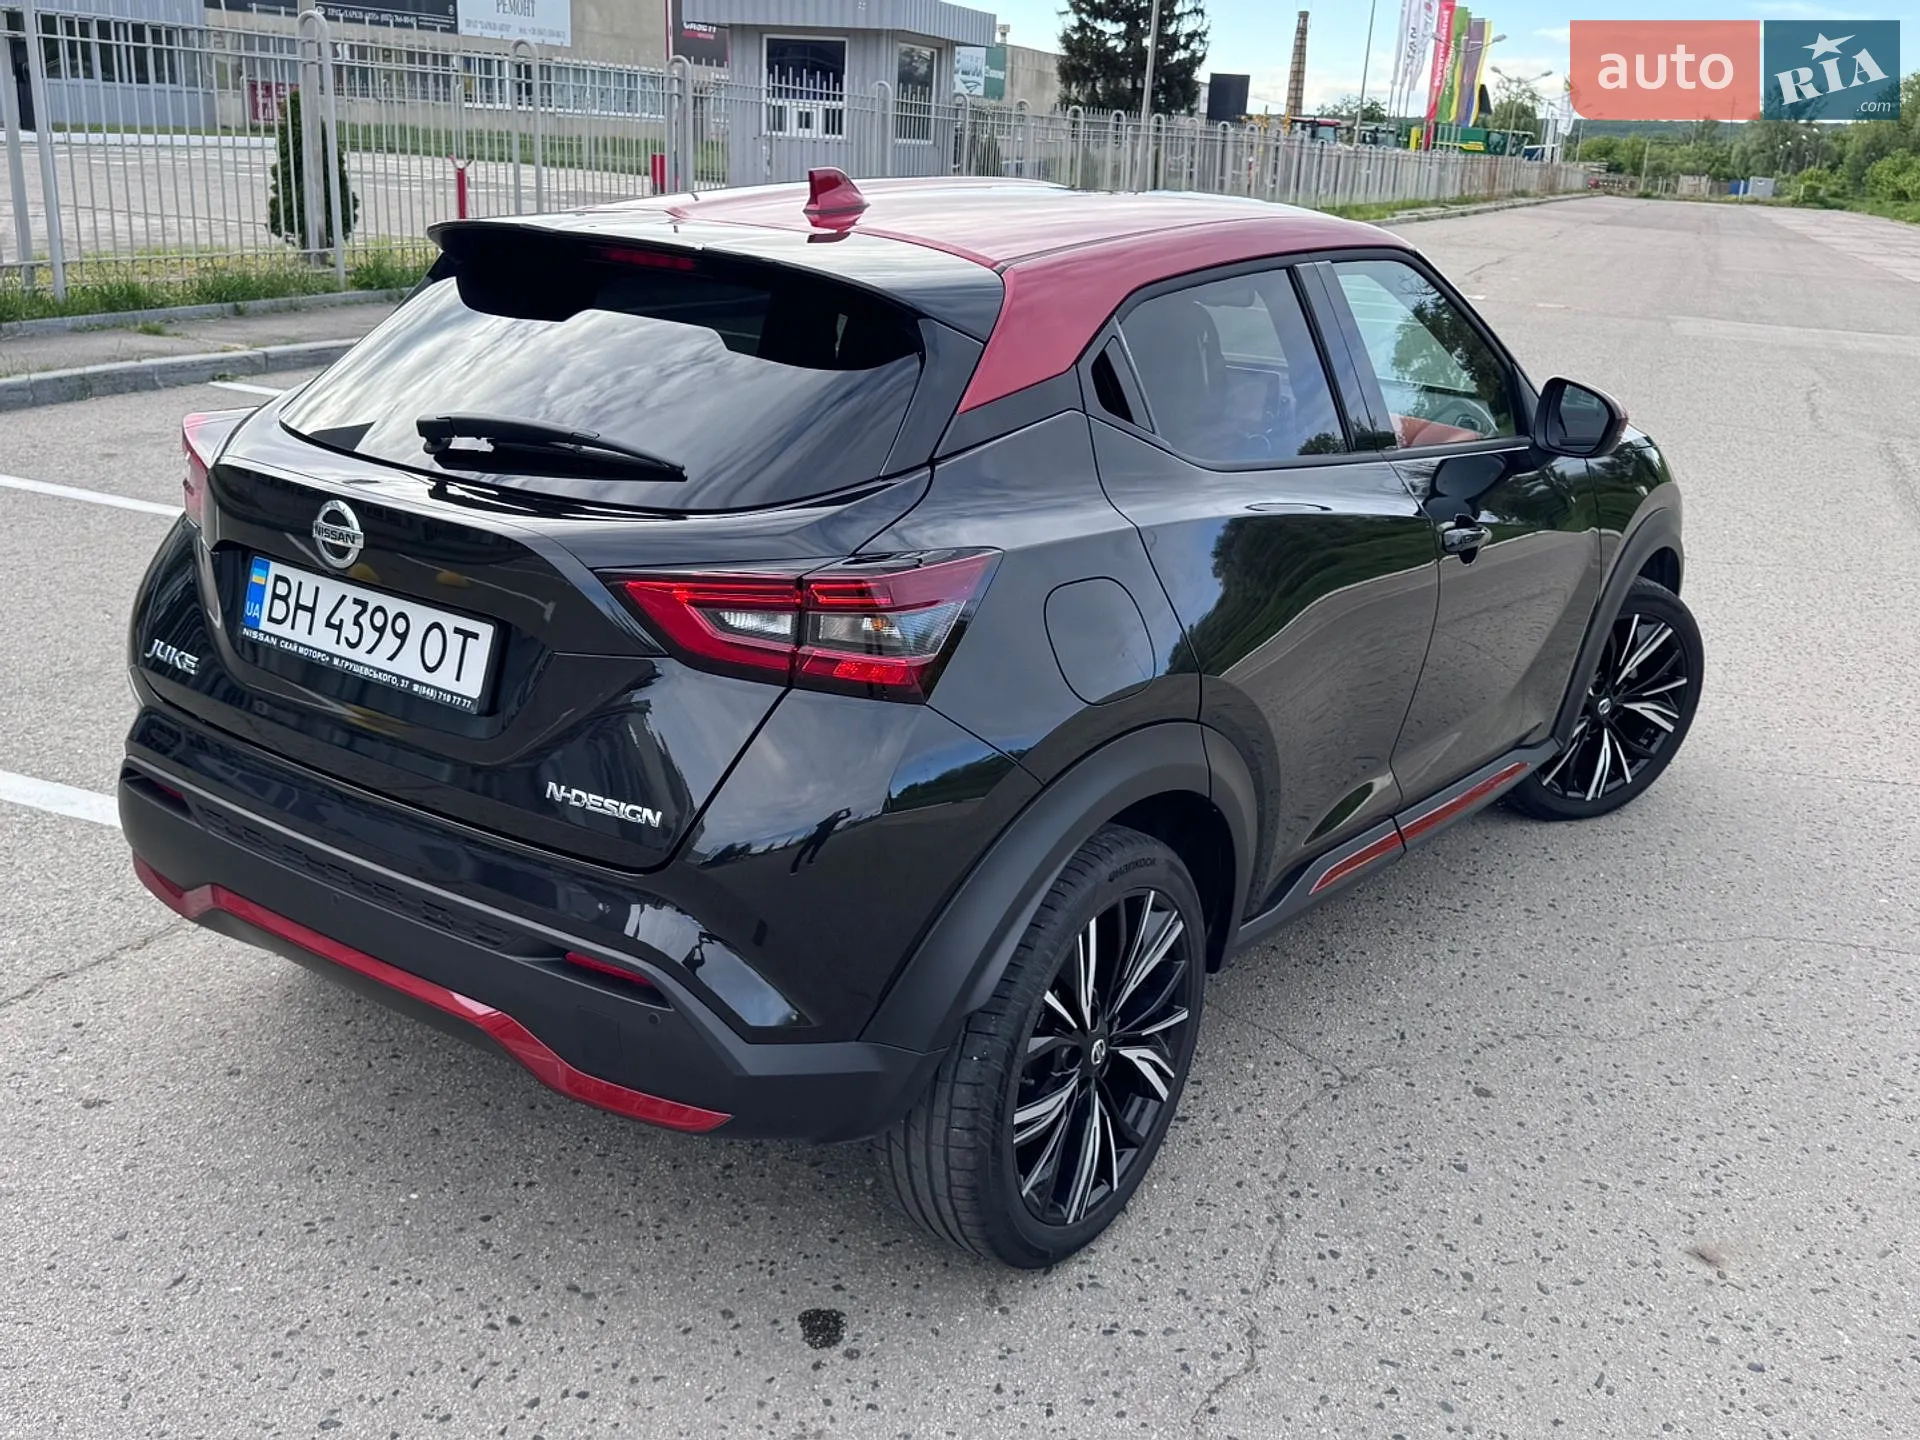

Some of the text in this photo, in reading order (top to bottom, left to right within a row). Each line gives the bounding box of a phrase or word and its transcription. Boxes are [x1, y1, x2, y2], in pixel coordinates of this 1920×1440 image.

[496, 0, 536, 17] РЕМОНТ
[314, 523, 356, 545] NISSAN
[246, 601, 260, 618] UA
[242, 627, 278, 647] NISSAN
[267, 573, 480, 683] BH 4399 OT
[143, 638, 200, 676] JUKE
[545, 781, 663, 828] N-DESIGN
